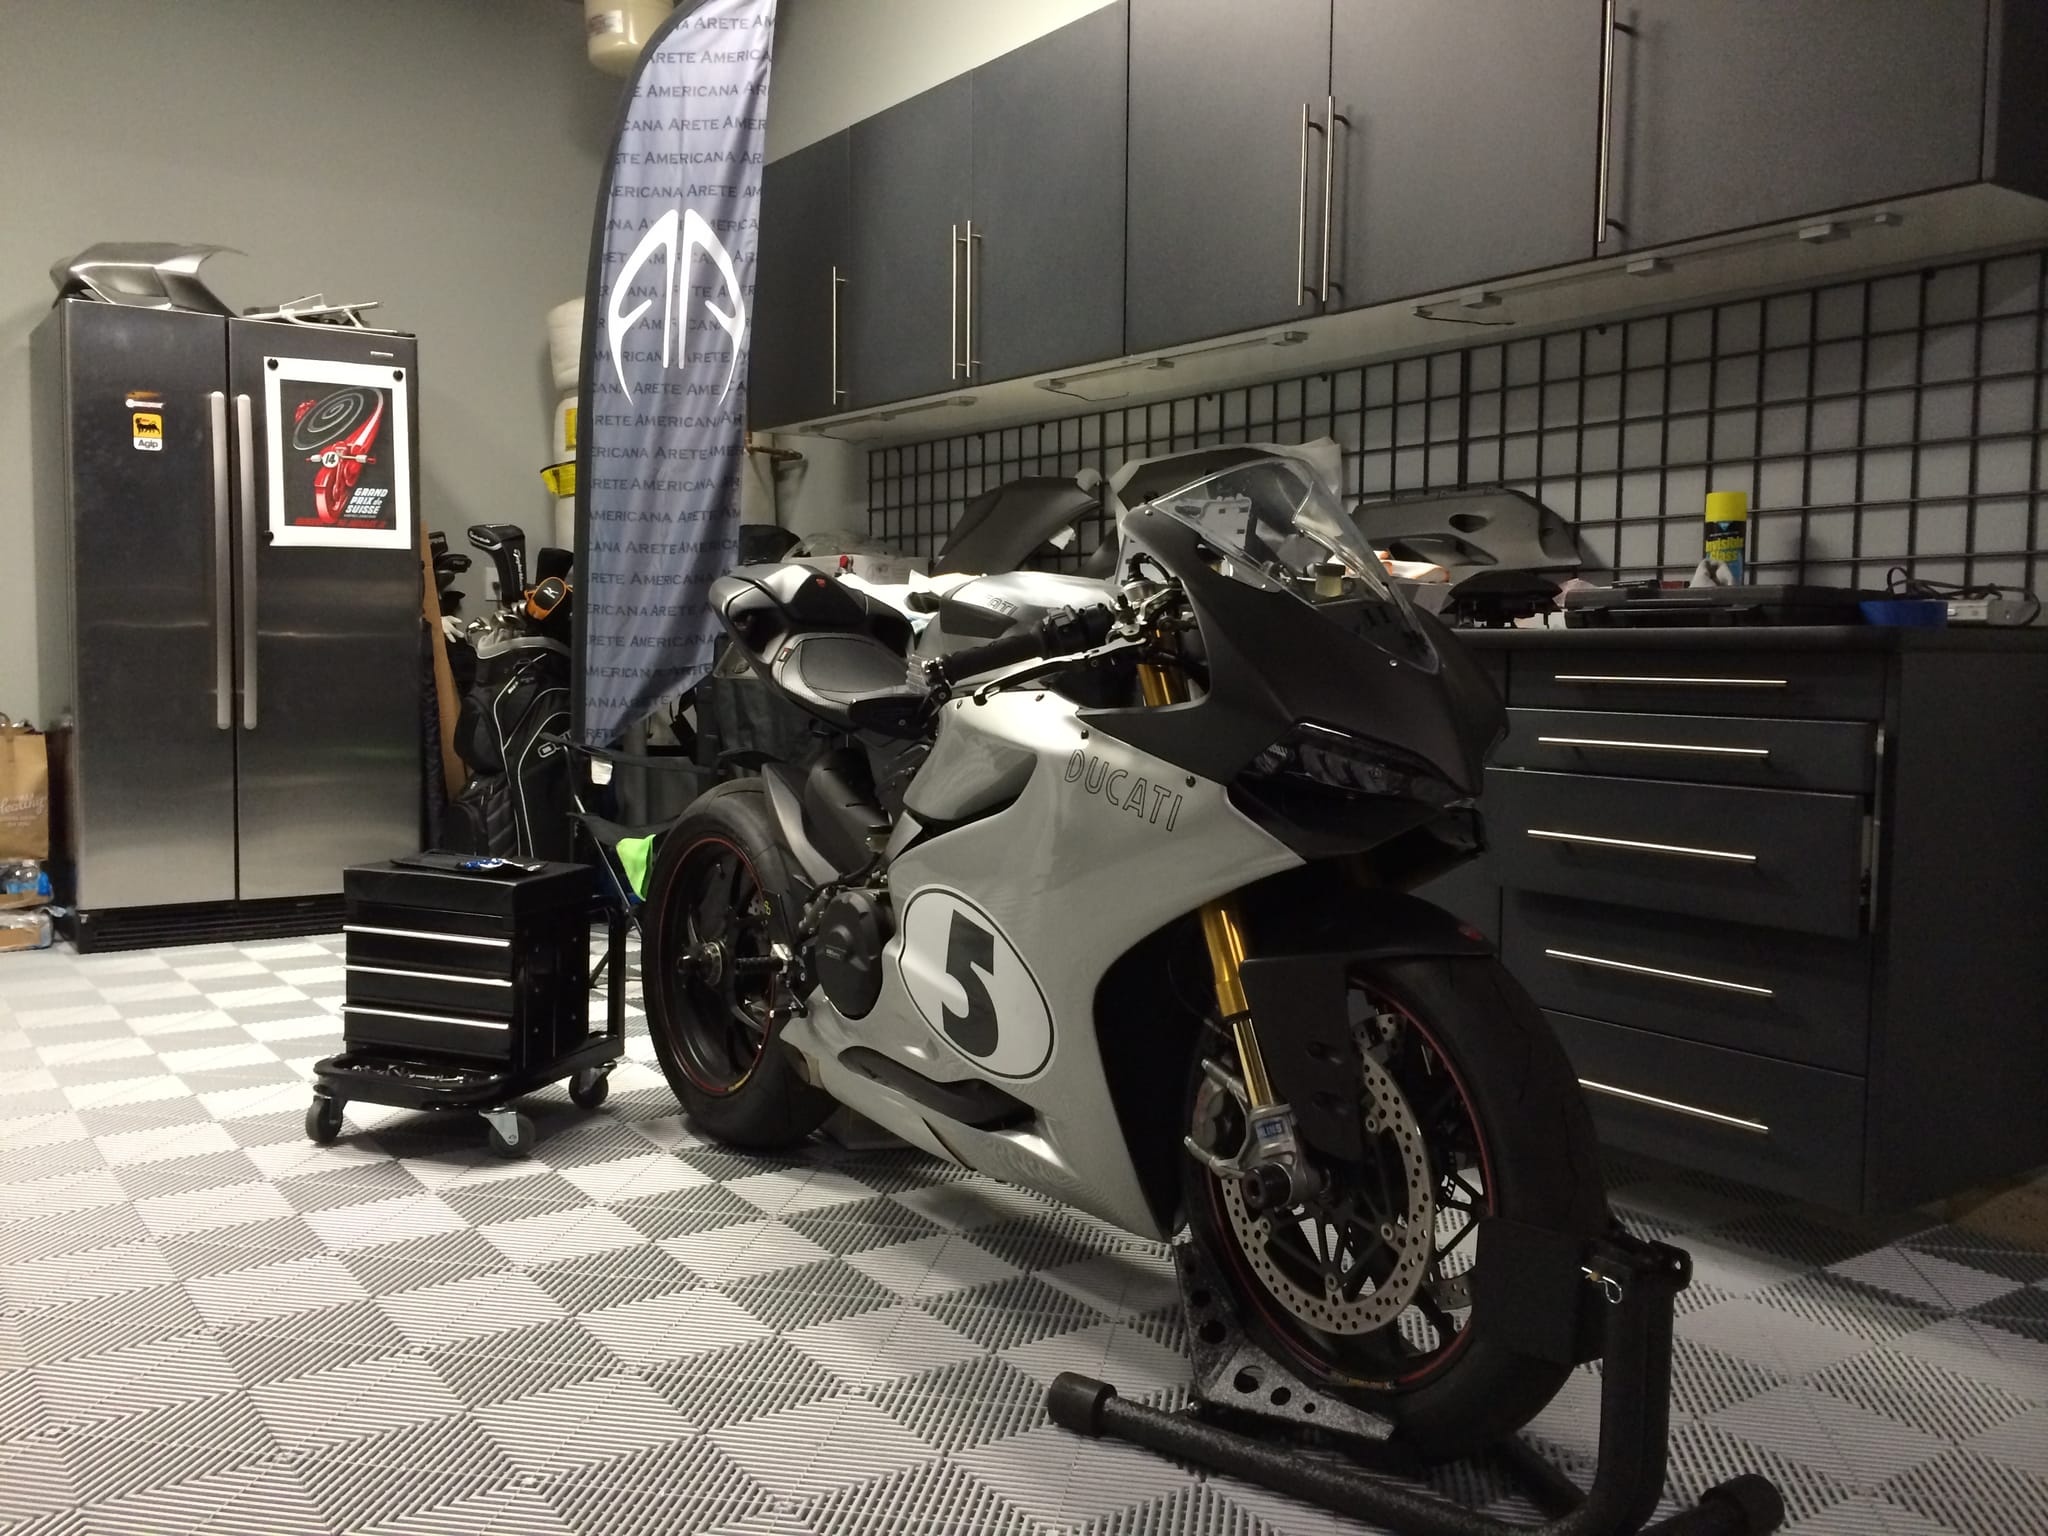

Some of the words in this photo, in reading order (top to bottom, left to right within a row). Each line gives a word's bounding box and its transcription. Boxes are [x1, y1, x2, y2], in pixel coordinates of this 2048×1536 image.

[694, 16, 749, 30] ARETE
[646, 84, 738, 98] AMERICANA
[668, 118, 720, 132] ARETE
[644, 151, 737, 165] AMERICANA
[687, 184, 737, 198] ARETE
[633, 382, 682, 395] ARETE
[138, 439, 159, 449] Agip
[325, 454, 336, 465] 14
[654, 446, 708, 460] ARETE
[354, 487, 389, 498] GRAND
[350, 496, 374, 505] PRIX
[345, 504, 381, 515] SUISSE
[625, 540, 677, 555] ARETE
[1064, 748, 1183, 832] DUCATI
[941, 908, 999, 1058] 5
